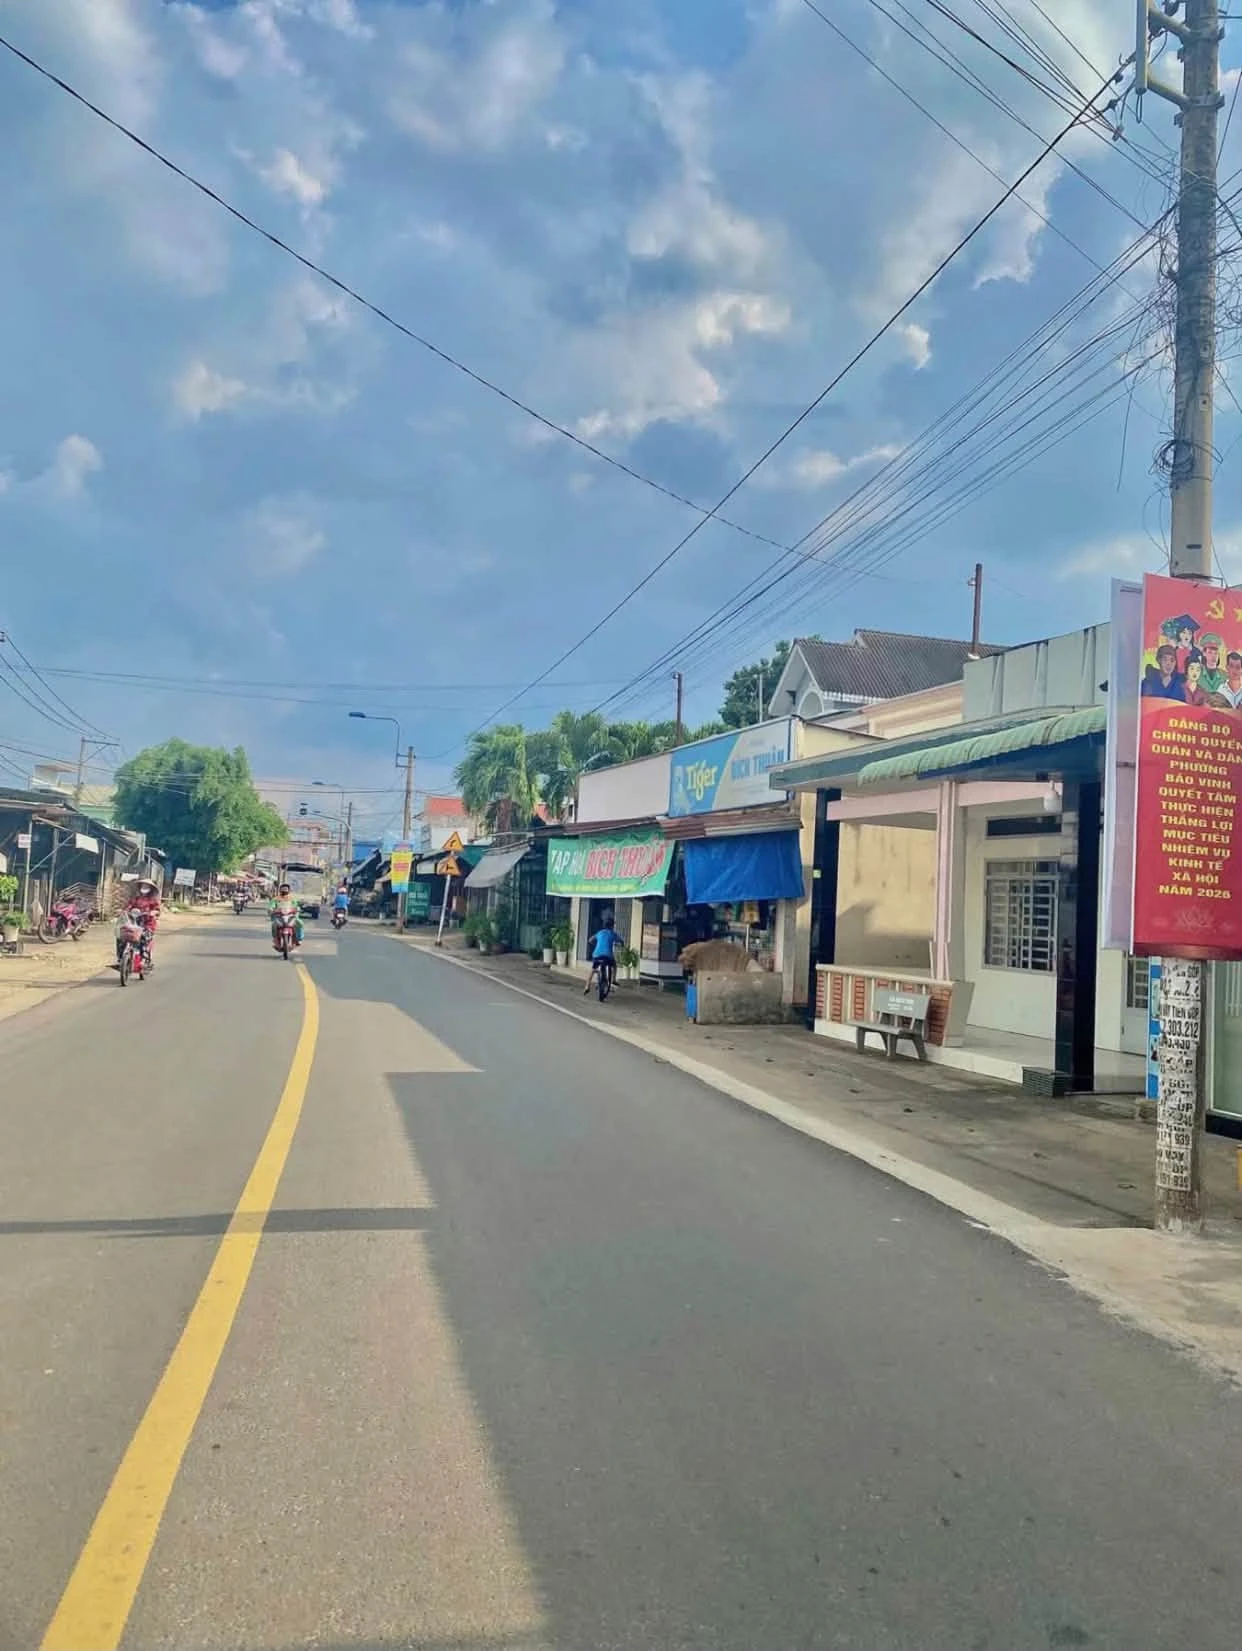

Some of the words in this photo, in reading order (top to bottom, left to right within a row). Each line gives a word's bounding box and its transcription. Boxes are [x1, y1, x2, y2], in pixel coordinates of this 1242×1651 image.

[1152, 729, 1196, 744] CHÍNH
[1212, 722, 1231, 736] BỘ
[1151, 743, 1191, 757] QUÂN
[1196, 749, 1213, 760] VÀ
[1169, 759, 1228, 775] PHƯỜNG
[686, 759, 718, 801] Tiger
[1198, 777, 1231, 790] VINH
[1159, 785, 1203, 799] QUYẾT
[1207, 792, 1237, 804] TÂM
[1160, 800, 1197, 813] THỰC
[1201, 805, 1234, 818] HIỆN
[1160, 814, 1208, 828] THẮNG
[1212, 820, 1233, 831] LỢI
[1163, 829, 1196, 842] MỤC
[1200, 832, 1230, 844] TIÊU
[1162, 843, 1208, 856] NHIỆM
[1213, 847, 1231, 860] VỤ
[1168, 857, 1203, 869] KINH
[1208, 859, 1224, 871] TẾ
[1172, 871, 1191, 882] XÃ
[1195, 872, 1219, 886] HỘI
[1159, 884, 1193, 897] NĂM
